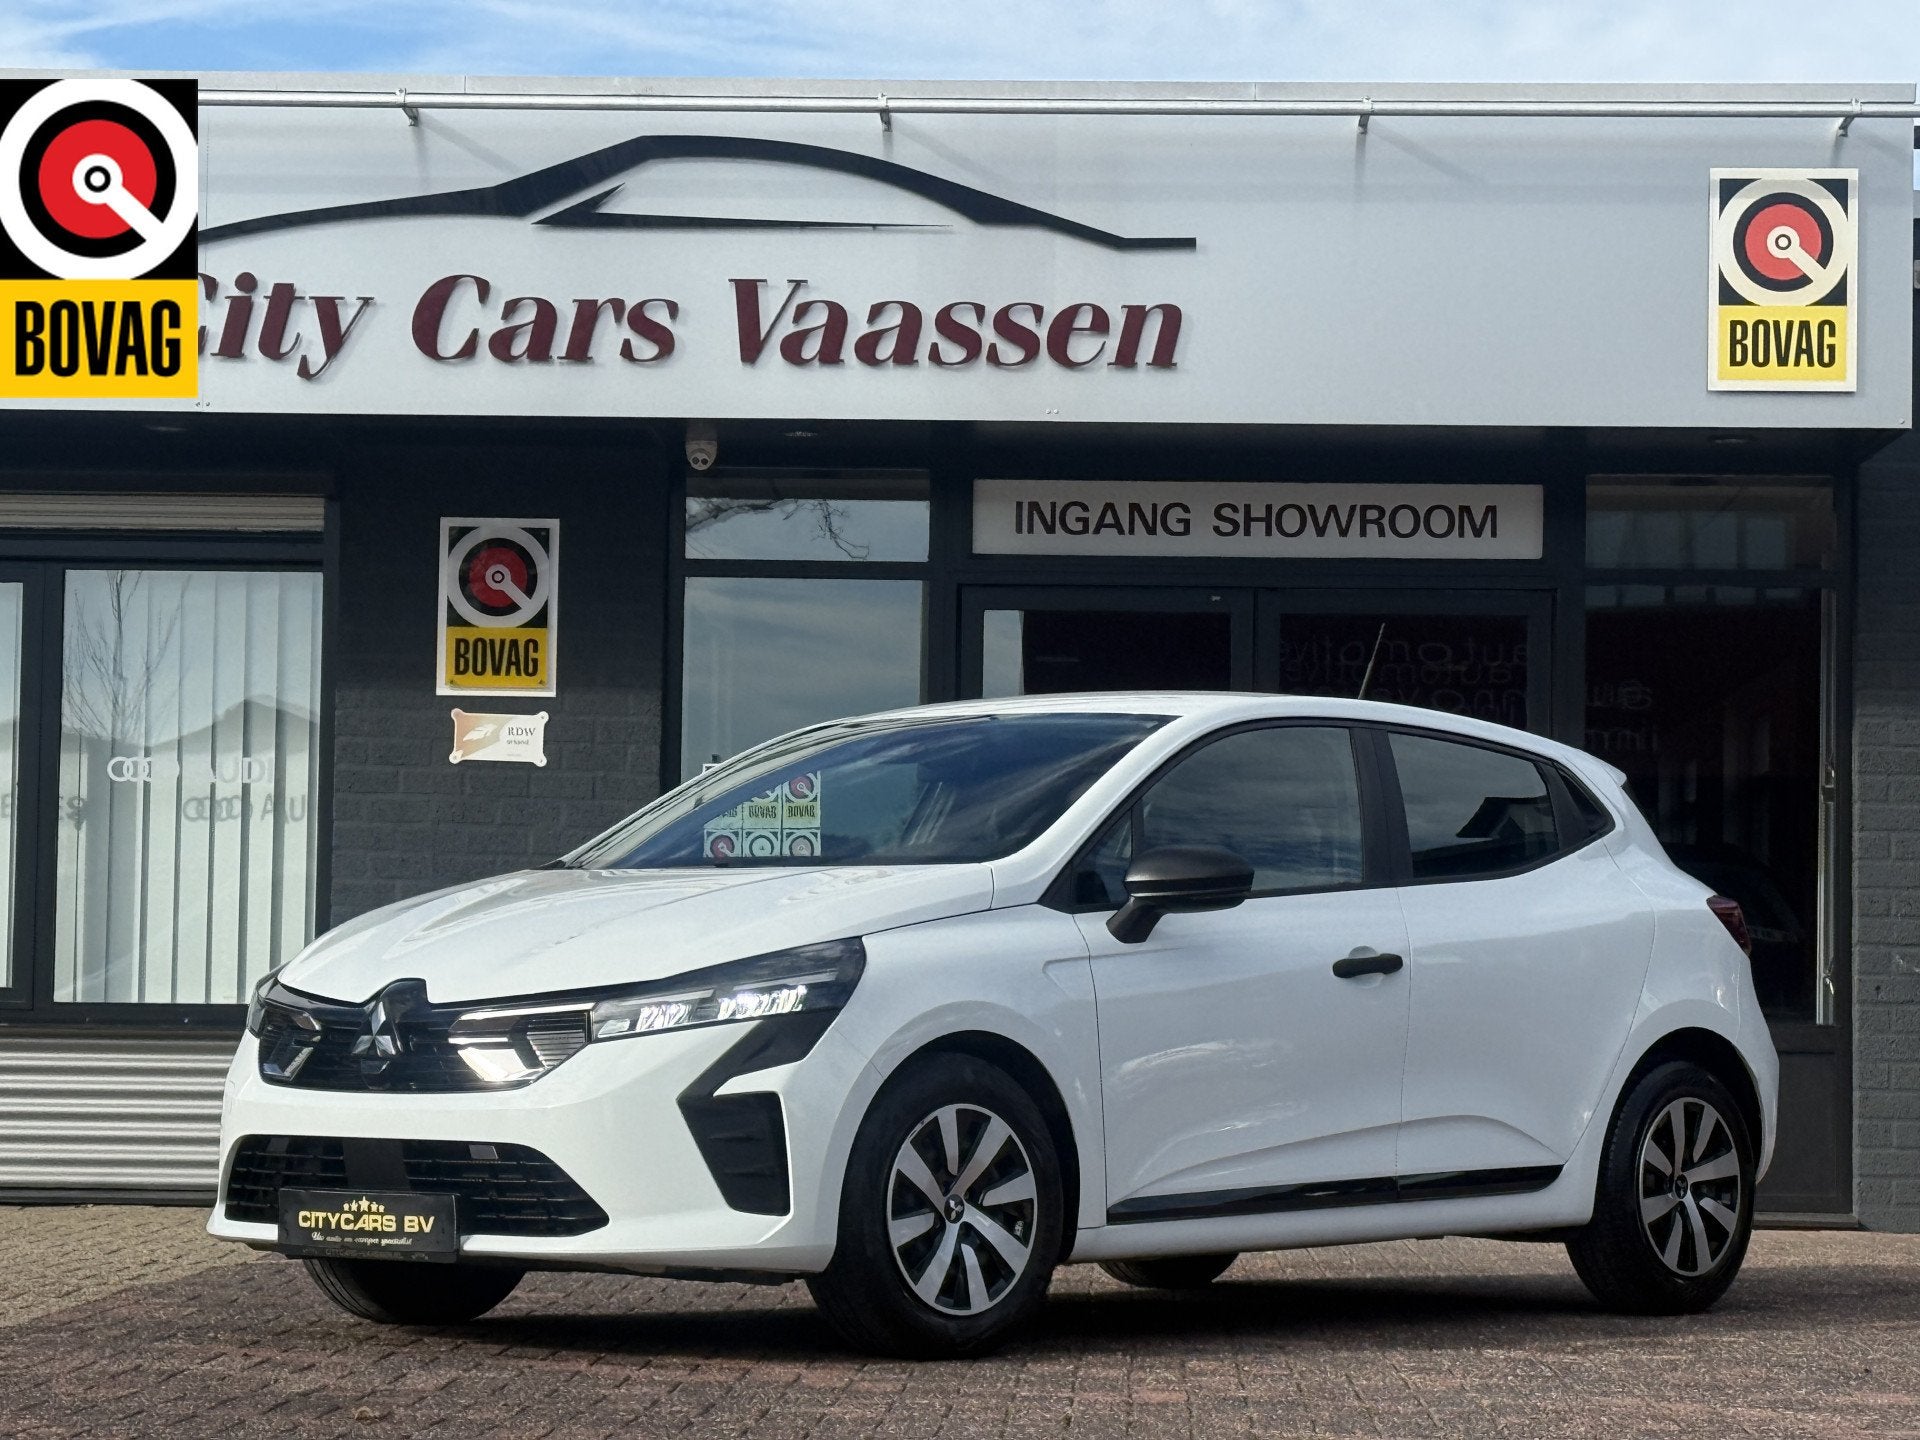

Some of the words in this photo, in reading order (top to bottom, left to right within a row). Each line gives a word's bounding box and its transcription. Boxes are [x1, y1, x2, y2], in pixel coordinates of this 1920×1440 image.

[198, 271, 374, 381] ity
[411, 274, 680, 364] Cars
[729, 278, 1183, 370] Vaassen
[1729, 319, 1836, 368] BOVAG
[1015, 500, 1192, 537] INGANG
[1212, 503, 1498, 539] SHOWROOM
[454, 638, 539, 677] BOVAG
[507, 726, 536, 737] RDW
[298, 1211, 397, 1233] CITYCARS
[404, 1215, 435, 1234] BV
